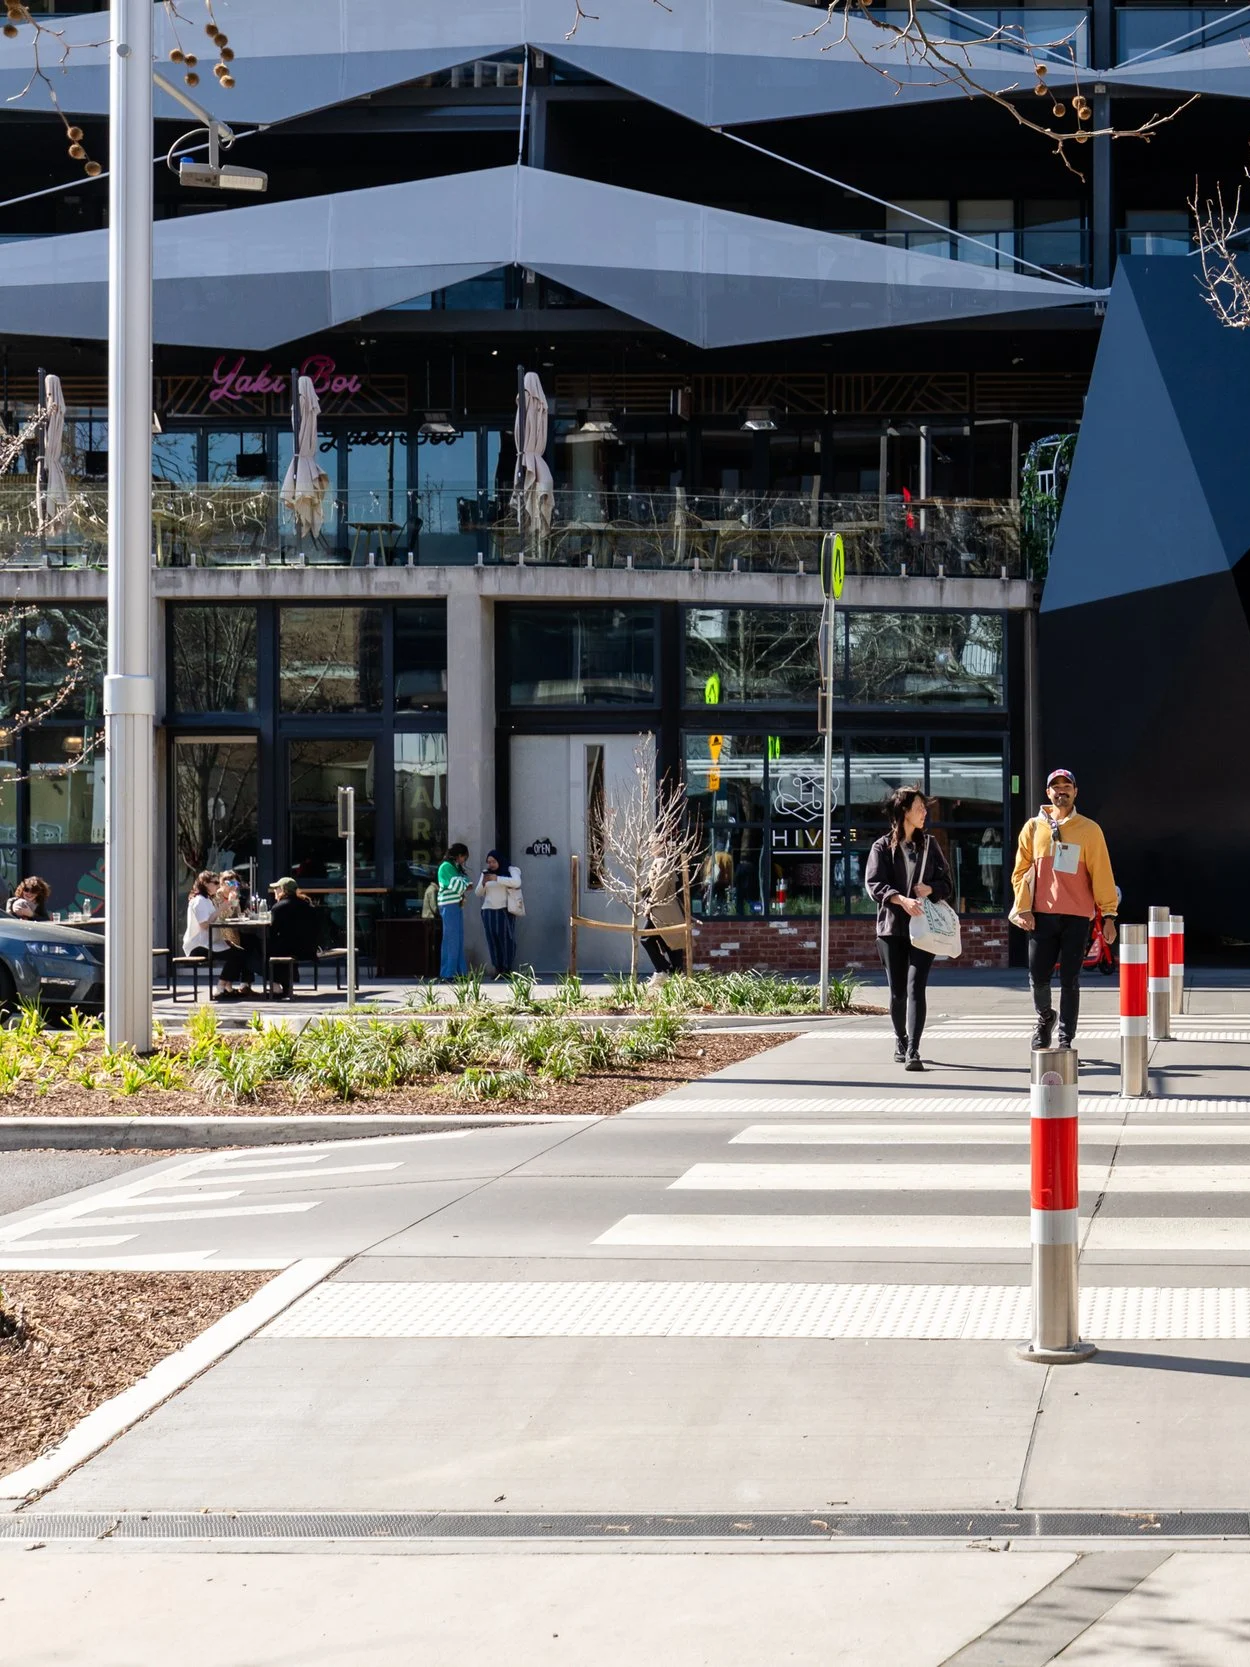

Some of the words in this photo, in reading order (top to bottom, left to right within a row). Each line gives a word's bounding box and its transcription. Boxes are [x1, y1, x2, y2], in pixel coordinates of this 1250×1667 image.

[209, 355, 287, 401] Yaki
[301, 354, 362, 394] Boi
[772, 829, 842, 847] HIVE
[533, 843, 551, 854] OPEN
